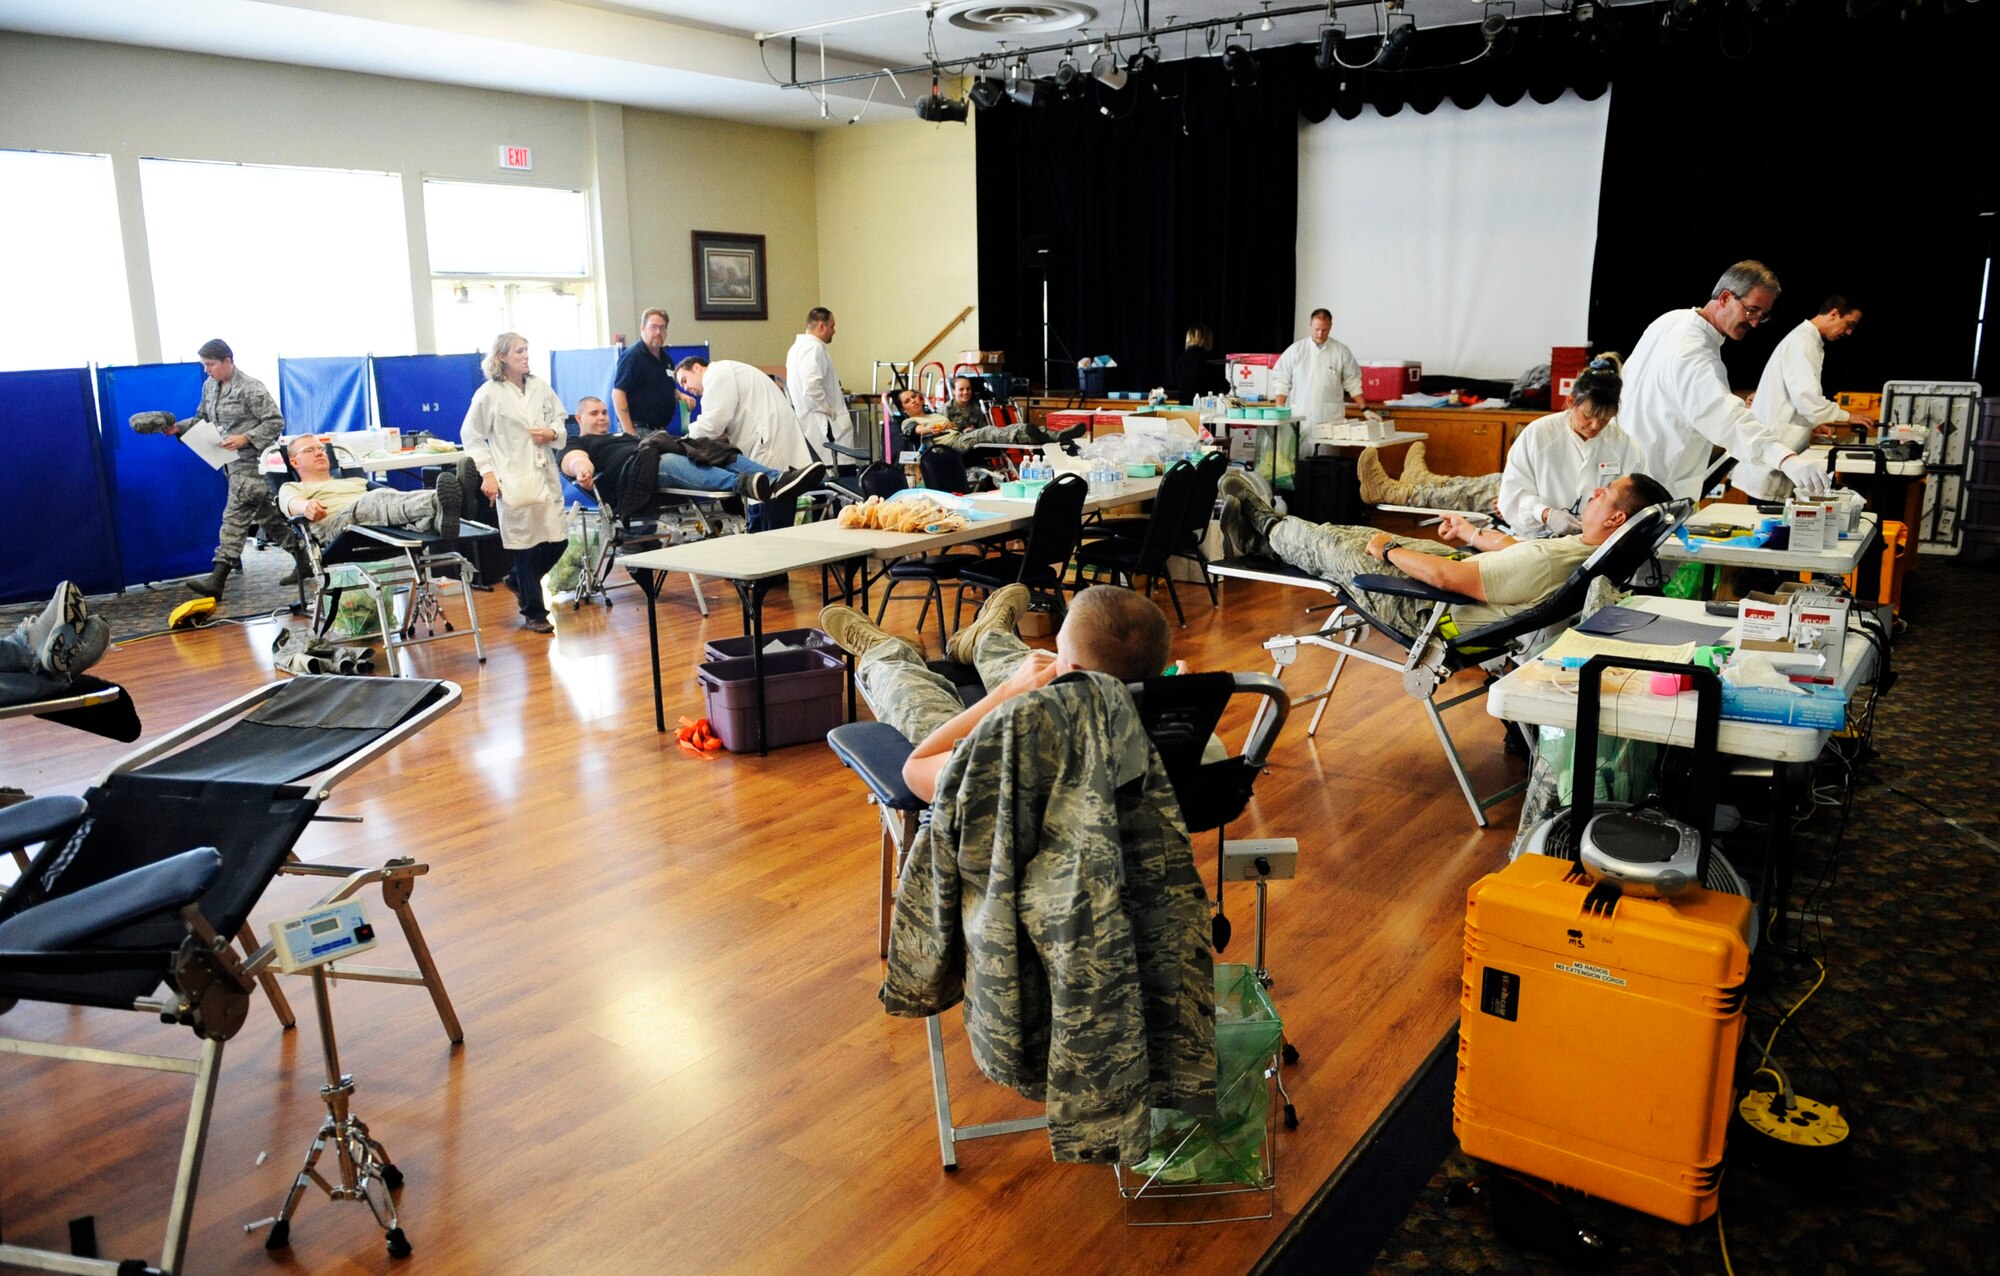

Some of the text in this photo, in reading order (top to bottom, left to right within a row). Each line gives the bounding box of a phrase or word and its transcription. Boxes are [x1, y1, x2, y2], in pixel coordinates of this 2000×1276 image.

[508, 147, 528, 167] EXIT
[1565, 966, 1601, 979] EXTENSION
[1602, 975, 1625, 985] CORDS
[1584, 965, 1609, 975] RADIOS
